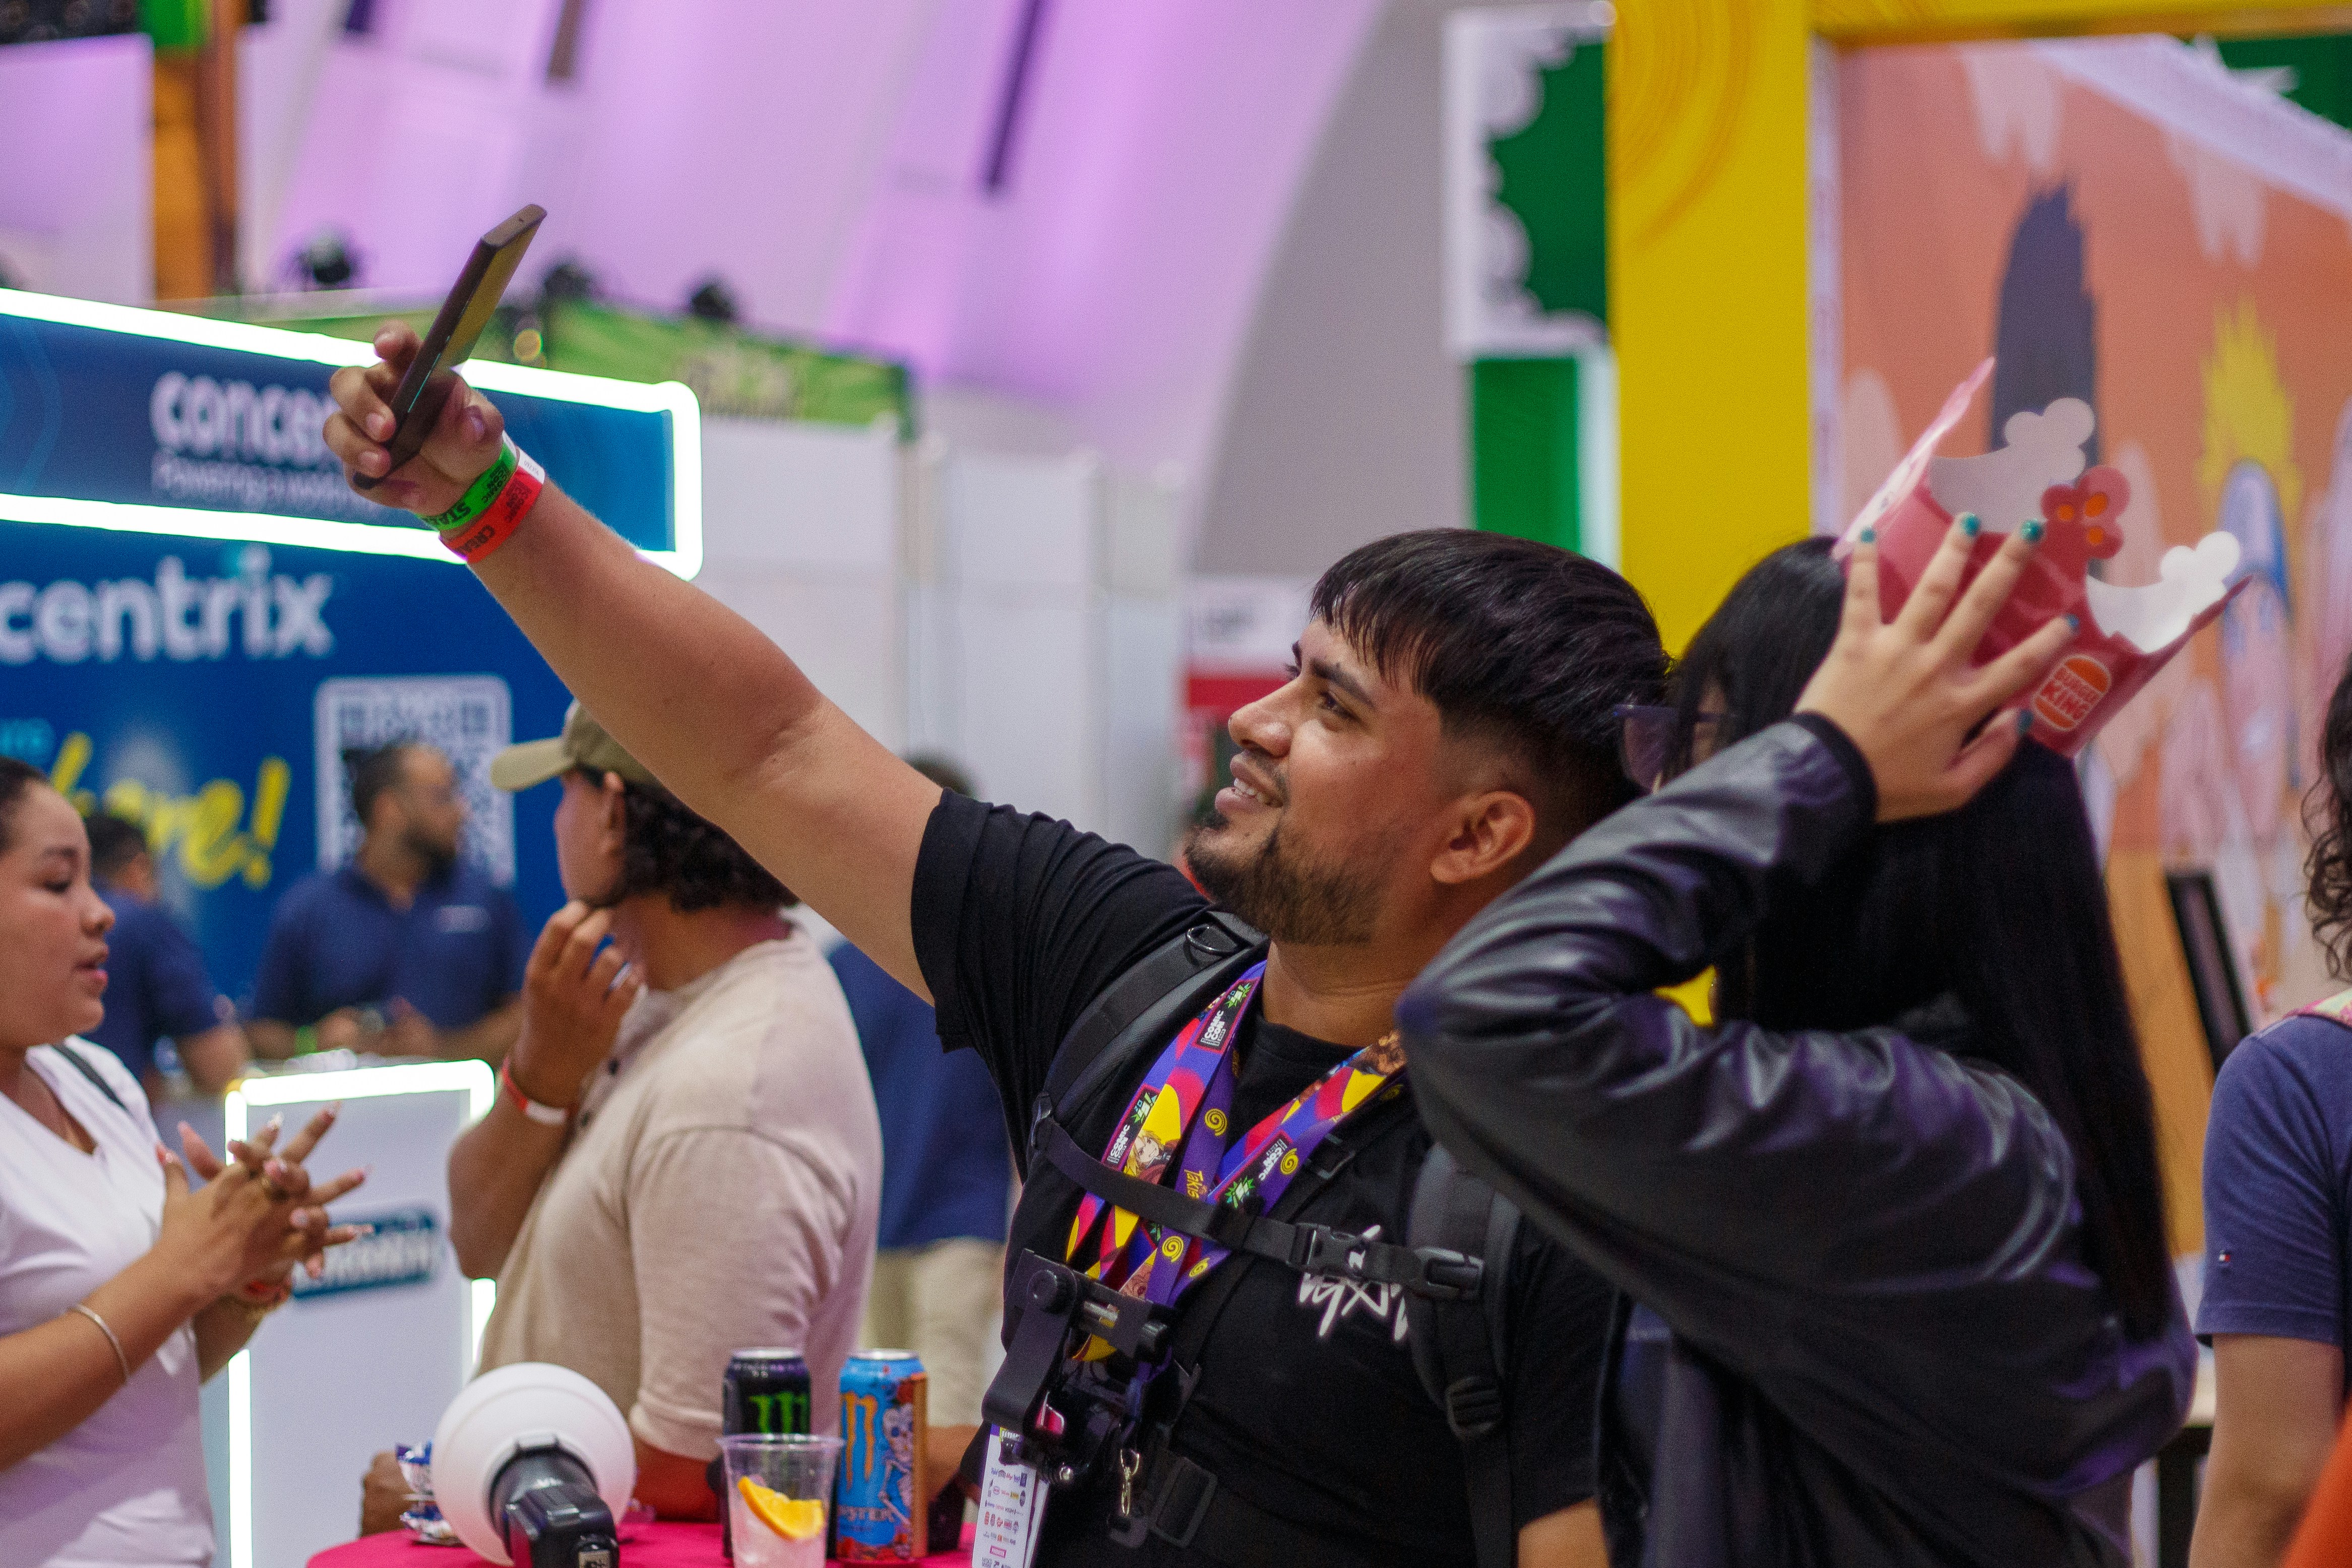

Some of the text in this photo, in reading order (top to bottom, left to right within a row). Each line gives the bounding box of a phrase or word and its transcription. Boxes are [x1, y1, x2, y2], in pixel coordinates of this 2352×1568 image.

[2041, 680, 2089, 720] KING
[2054, 667, 2100, 704] BURGER
[1203, 1010, 1224, 1039] COMIC
[1210, 1020, 1225, 1040] CON
[1109, 1123, 1130, 1156] COMIC
[1113, 1136, 1128, 1157] CON
[1262, 1146, 1282, 1167] CON
[1184, 1170, 1204, 1200] Takis
